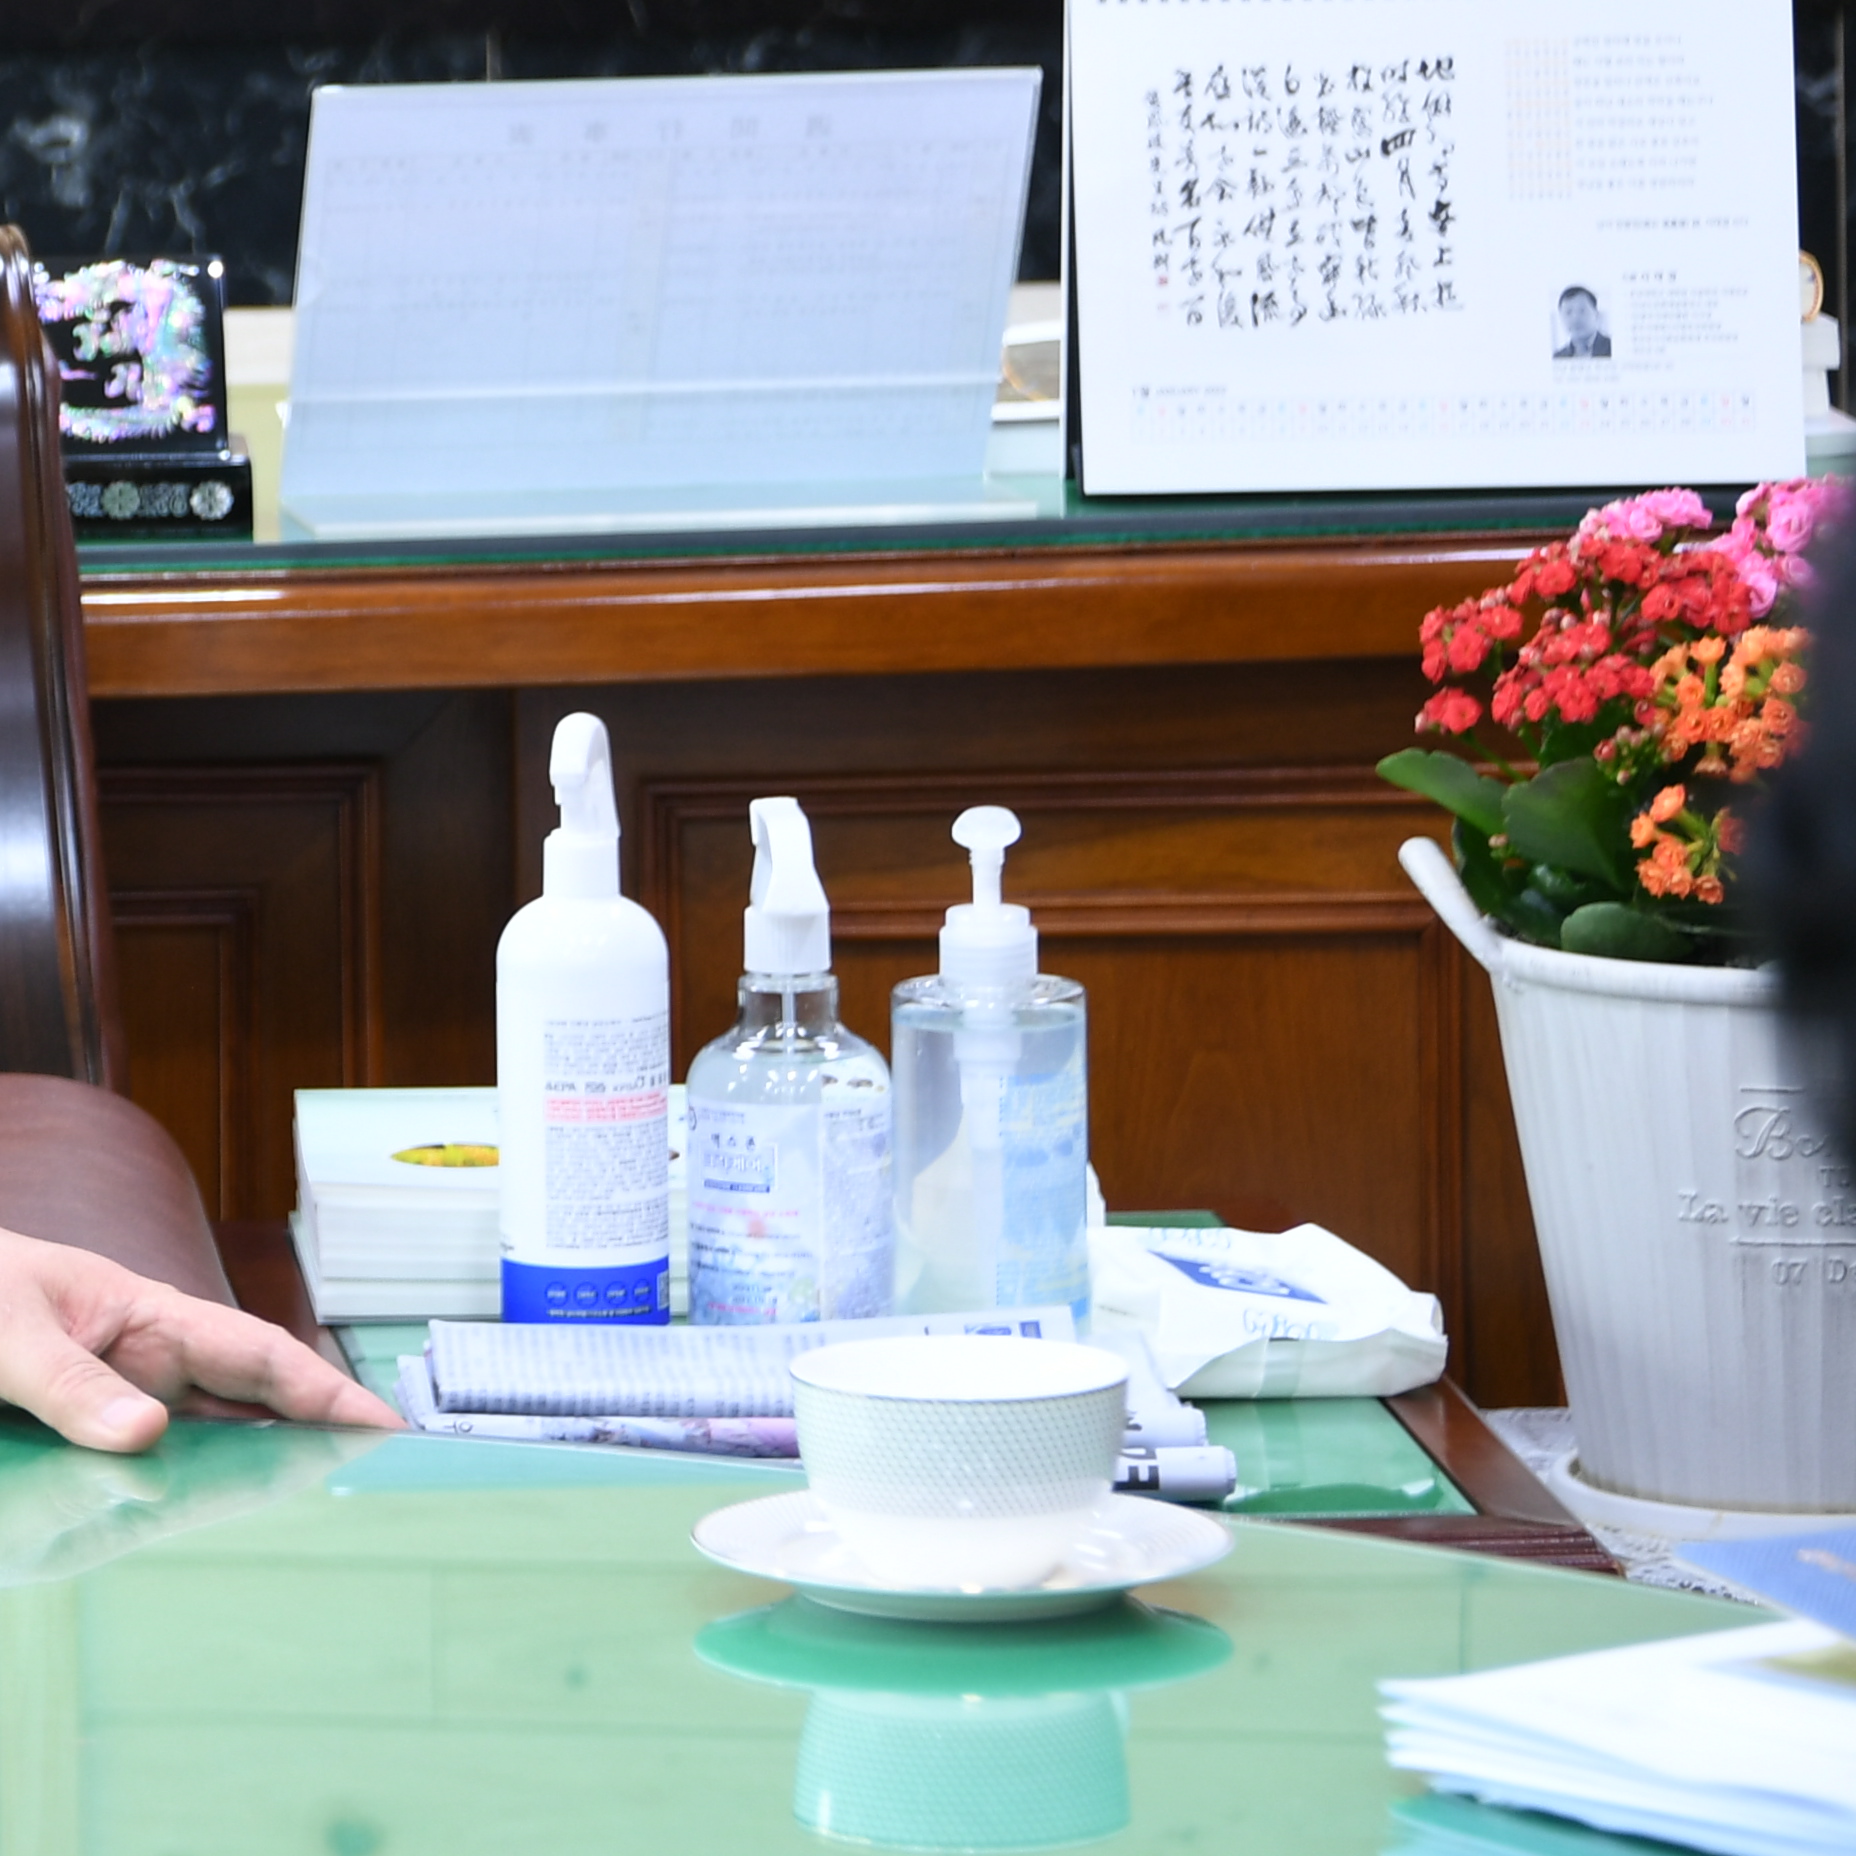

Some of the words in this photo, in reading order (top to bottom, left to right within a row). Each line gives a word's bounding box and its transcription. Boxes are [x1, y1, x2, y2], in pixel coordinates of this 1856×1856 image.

[1733, 1104, 1833, 1161] Bo
[1677, 1189, 1729, 1224] La
[1737, 1195, 1800, 1228] vie
[1771, 1256, 1807, 1285] 07
